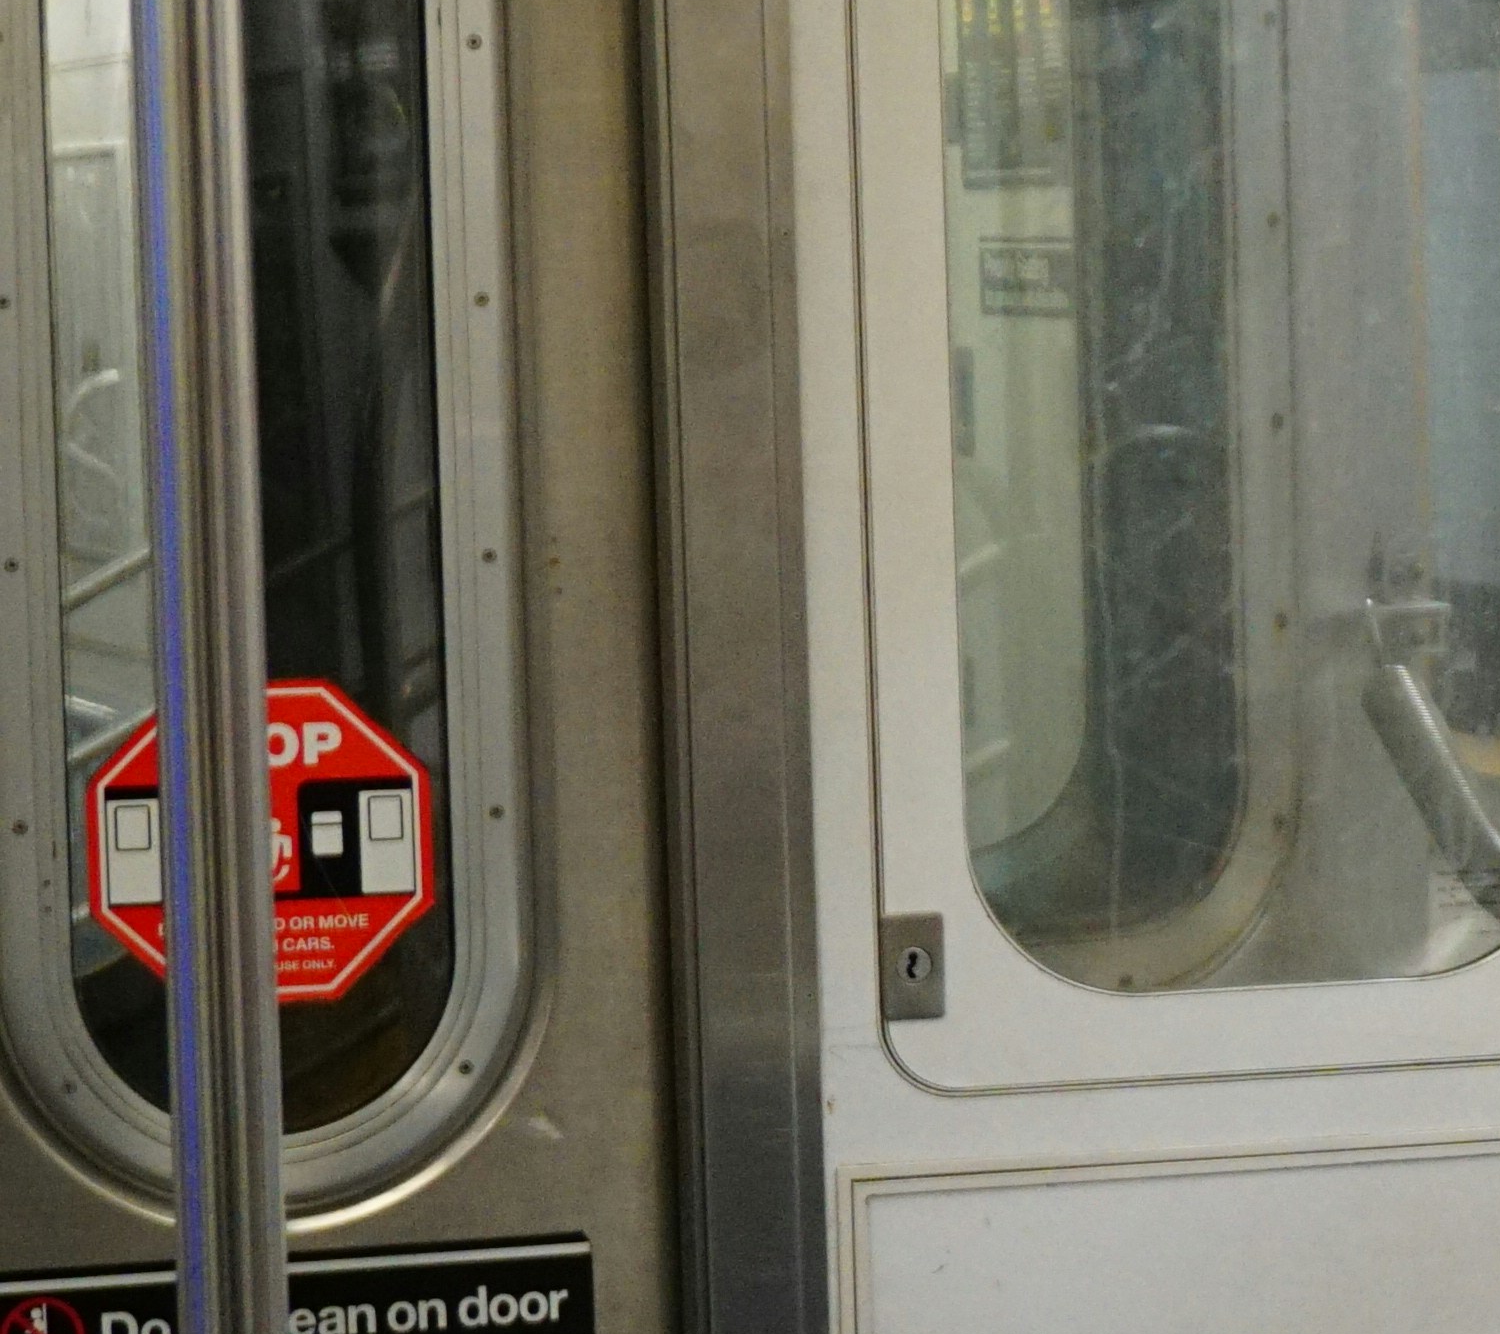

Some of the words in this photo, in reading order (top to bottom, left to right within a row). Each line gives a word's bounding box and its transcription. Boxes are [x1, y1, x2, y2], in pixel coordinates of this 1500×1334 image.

[266, 721, 343, 768] OP
[289, 915, 315, 931] OR
[318, 912, 370, 929] MOVE
[282, 936, 335, 952] CARS.
[387, 1296, 447, 1333] on
[457, 1285, 569, 1327] door
